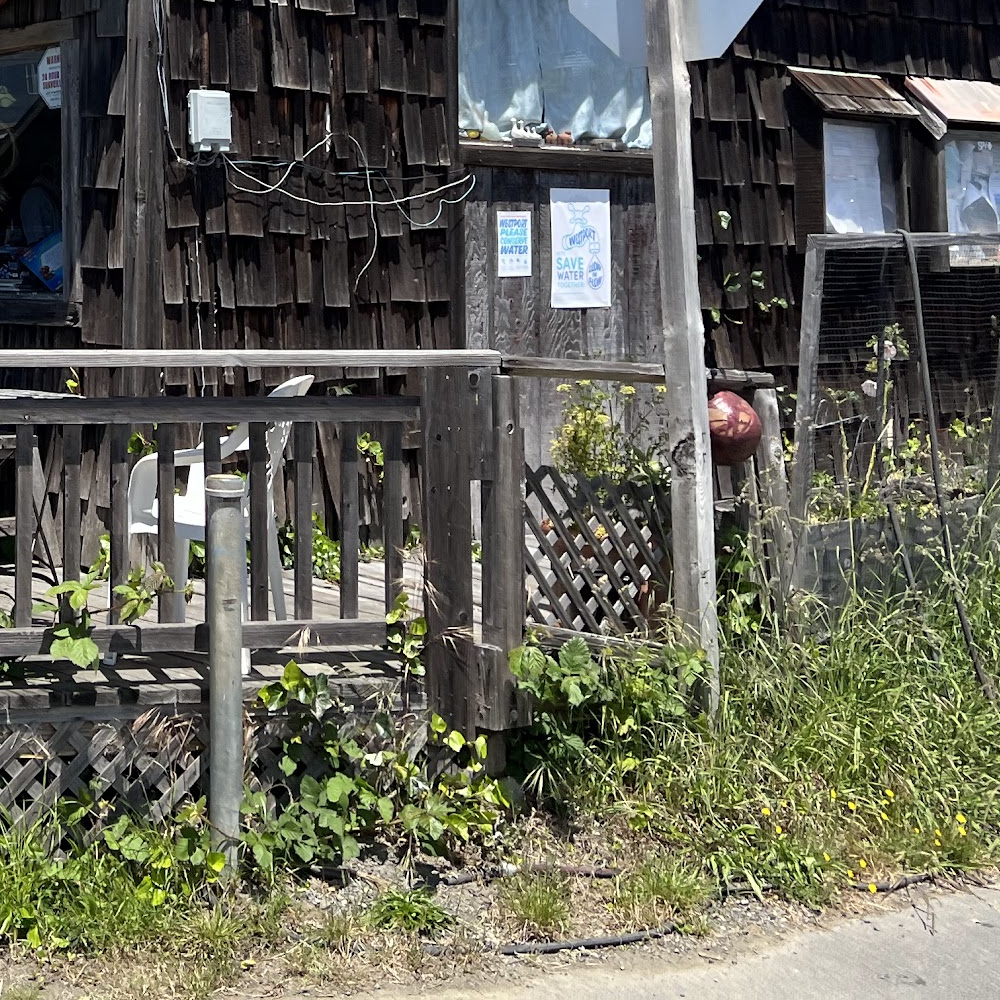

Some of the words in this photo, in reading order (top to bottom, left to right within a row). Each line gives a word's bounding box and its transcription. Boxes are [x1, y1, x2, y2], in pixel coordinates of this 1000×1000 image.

[500, 219, 528, 228] WESTPORT
[500, 228, 528, 237] PLEASE
[500, 245, 528, 255] WATER
[557, 257, 584, 270] SAVE
[557, 271, 584, 280] WATER
